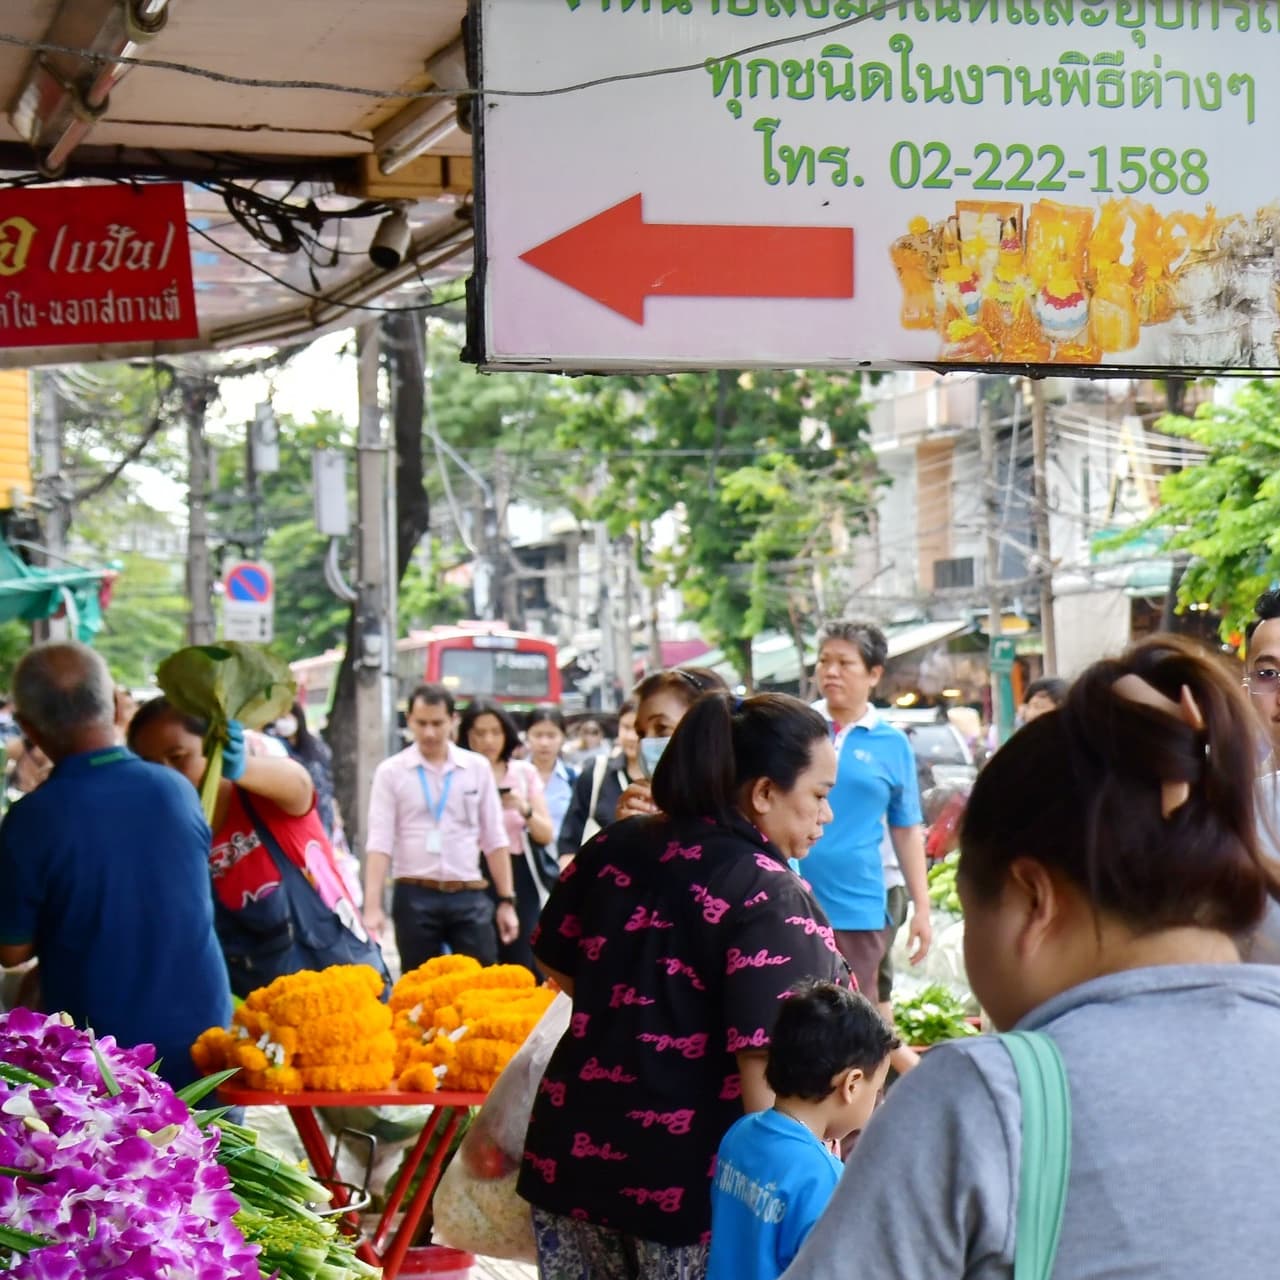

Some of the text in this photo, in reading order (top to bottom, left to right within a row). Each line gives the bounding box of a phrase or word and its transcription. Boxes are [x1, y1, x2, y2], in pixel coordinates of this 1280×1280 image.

[704, 33, 1257, 123] ทุกชนิดในงานพิธีต่างๆ
[752, 116, 1210, 195] โทร. 02-222-1588
[726, 948, 792, 975] Barbie
[636, 1032, 708, 1059] Barbie
[625, 1109, 695, 1135] Barbie
[570, 1132, 628, 1160] Barbie
